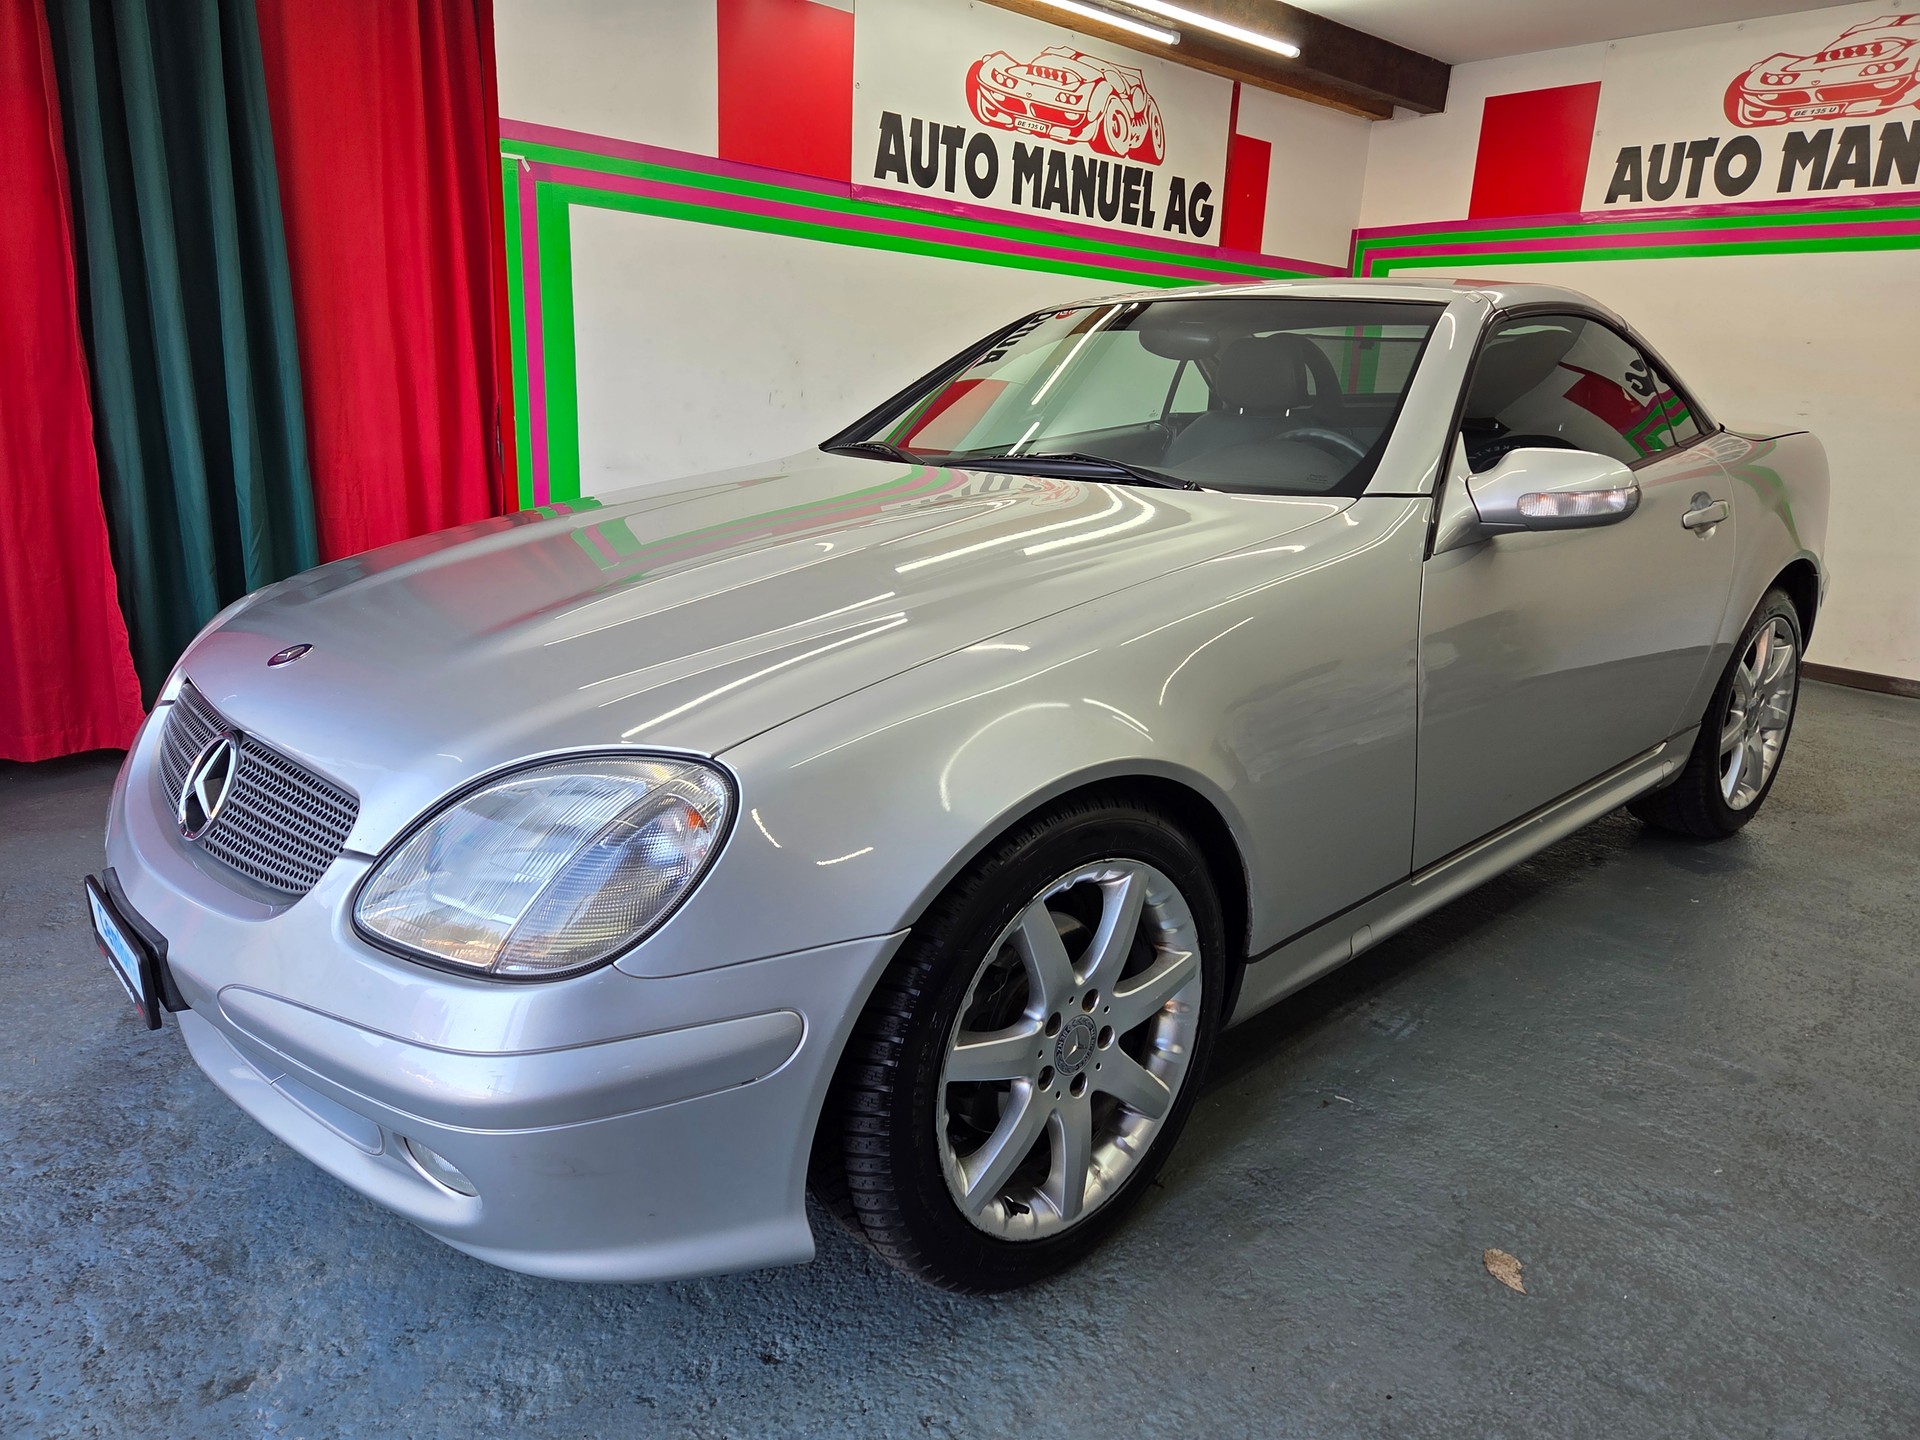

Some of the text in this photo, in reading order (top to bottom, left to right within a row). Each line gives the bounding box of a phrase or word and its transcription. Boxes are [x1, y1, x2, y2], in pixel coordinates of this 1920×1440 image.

[873, 110, 1215, 238] AUTO MANUEL AG
[1603, 135, 1762, 204] AUTO
